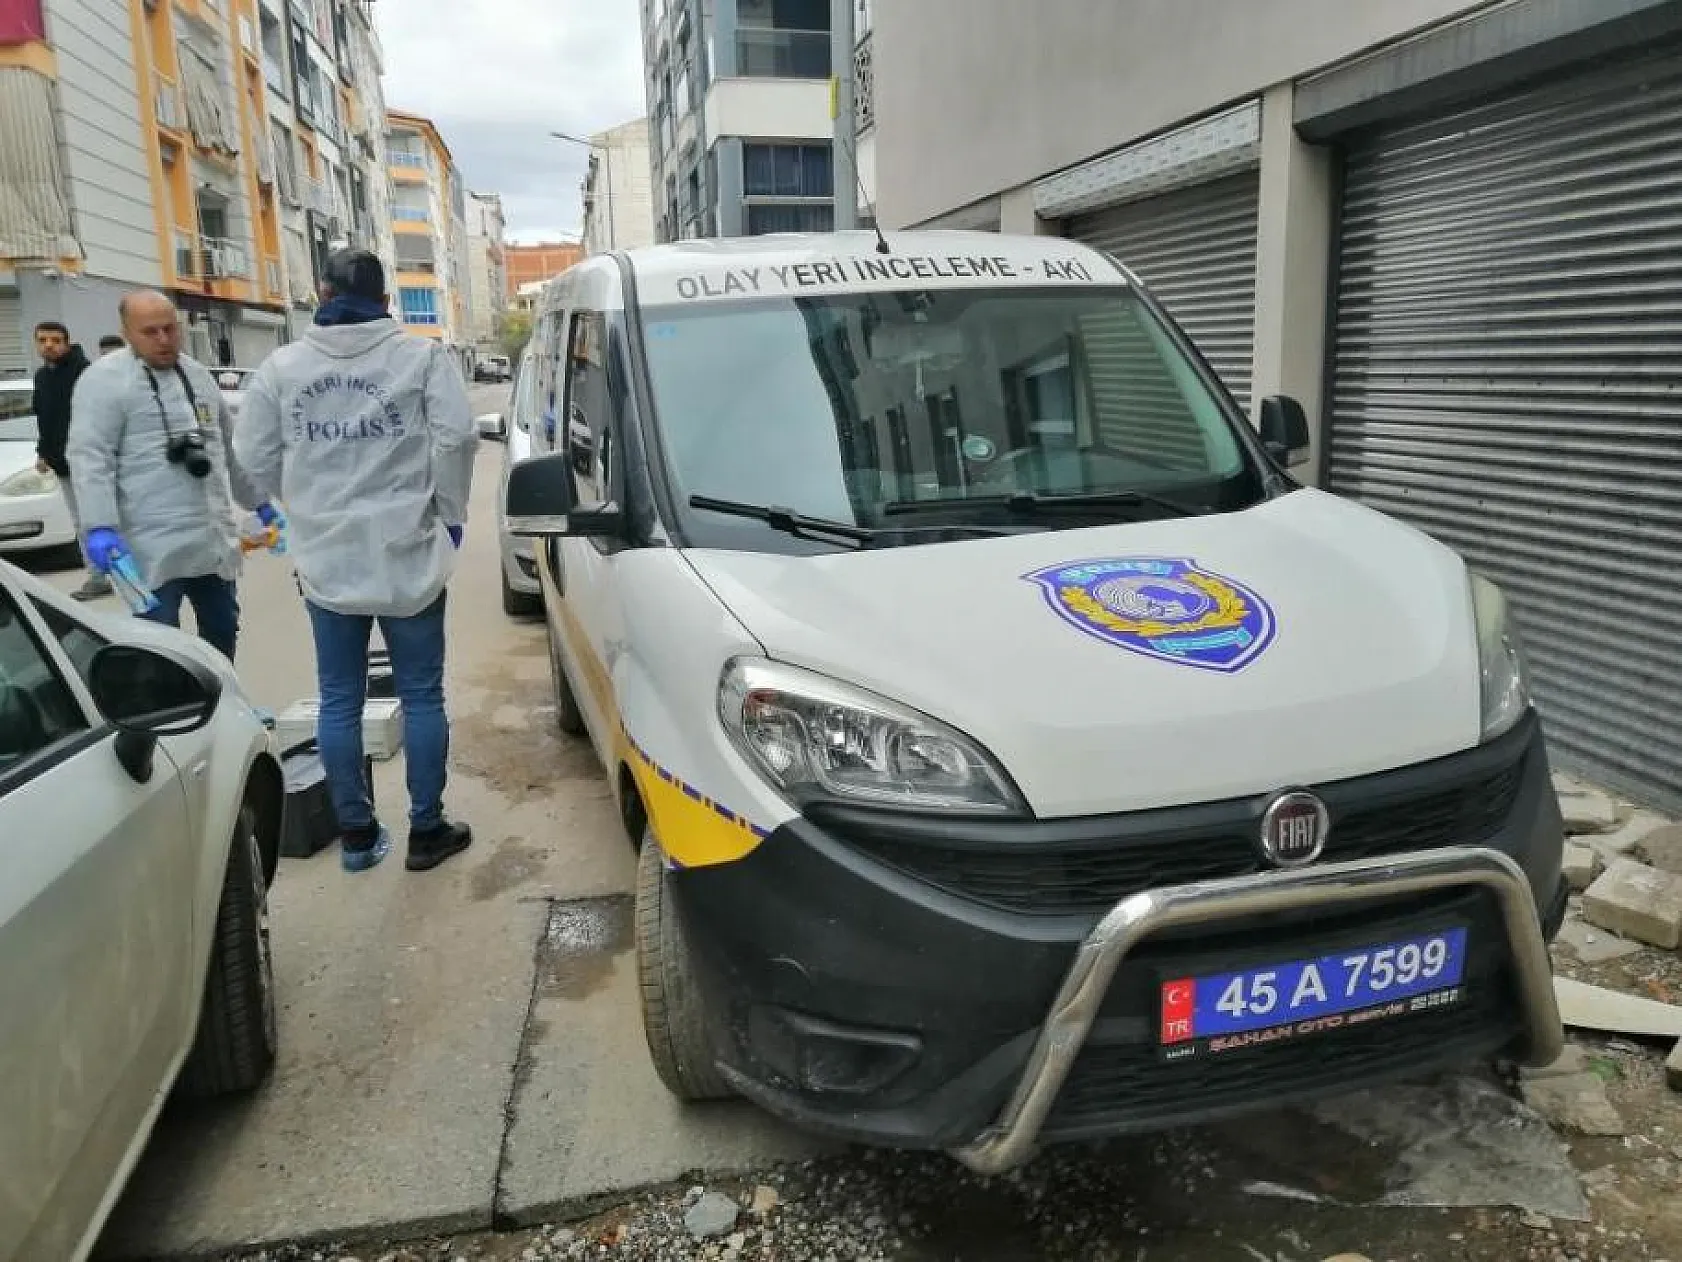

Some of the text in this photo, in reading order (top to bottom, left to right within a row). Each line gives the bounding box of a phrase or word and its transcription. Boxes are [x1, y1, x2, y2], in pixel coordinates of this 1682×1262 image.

[676, 267, 762, 299] OLAY
[770, 257, 847, 288] YERİ
[853, 255, 1017, 280] İNCELEME
[1043, 256, 1093, 282] AKİ
[1279, 813, 1316, 851] FIAT
[1215, 938, 1447, 1017] 45 A 7599
[1166, 1018, 1189, 1037] TR
